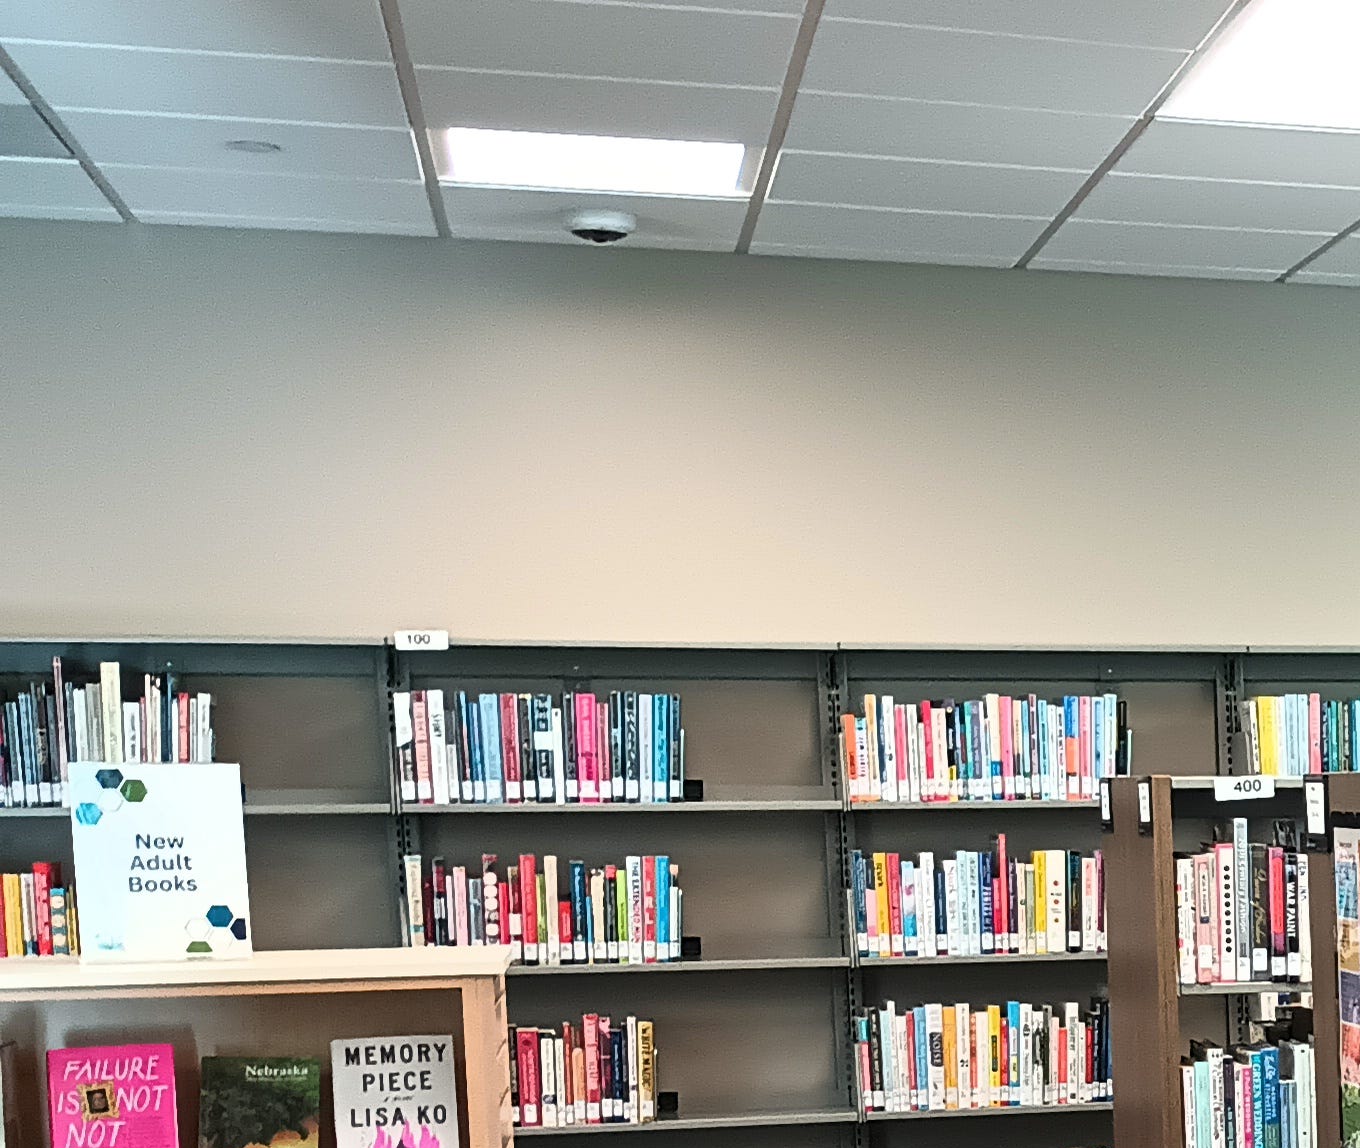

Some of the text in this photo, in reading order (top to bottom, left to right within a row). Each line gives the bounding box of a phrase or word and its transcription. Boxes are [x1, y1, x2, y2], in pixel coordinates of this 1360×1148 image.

[407, 633, 431, 645] 100
[1233, 779, 1262, 793] 400
[135, 833, 184, 850] New
[130, 855, 193, 872] Adult
[128, 876, 198, 893] Books
[1286, 882, 1296, 937] WAR PAINT
[344, 1043, 447, 1066] MEMORY
[932, 1034, 941, 1064] NOISE
[63, 1055, 160, 1081] FAILURE
[245, 1064, 309, 1078] Nebraska
[362, 1070, 433, 1092] PIECE
[57, 1084, 169, 1115] IS NOT
[350, 1104, 447, 1127] LISA KO
[65, 1120, 127, 1148] NOT
